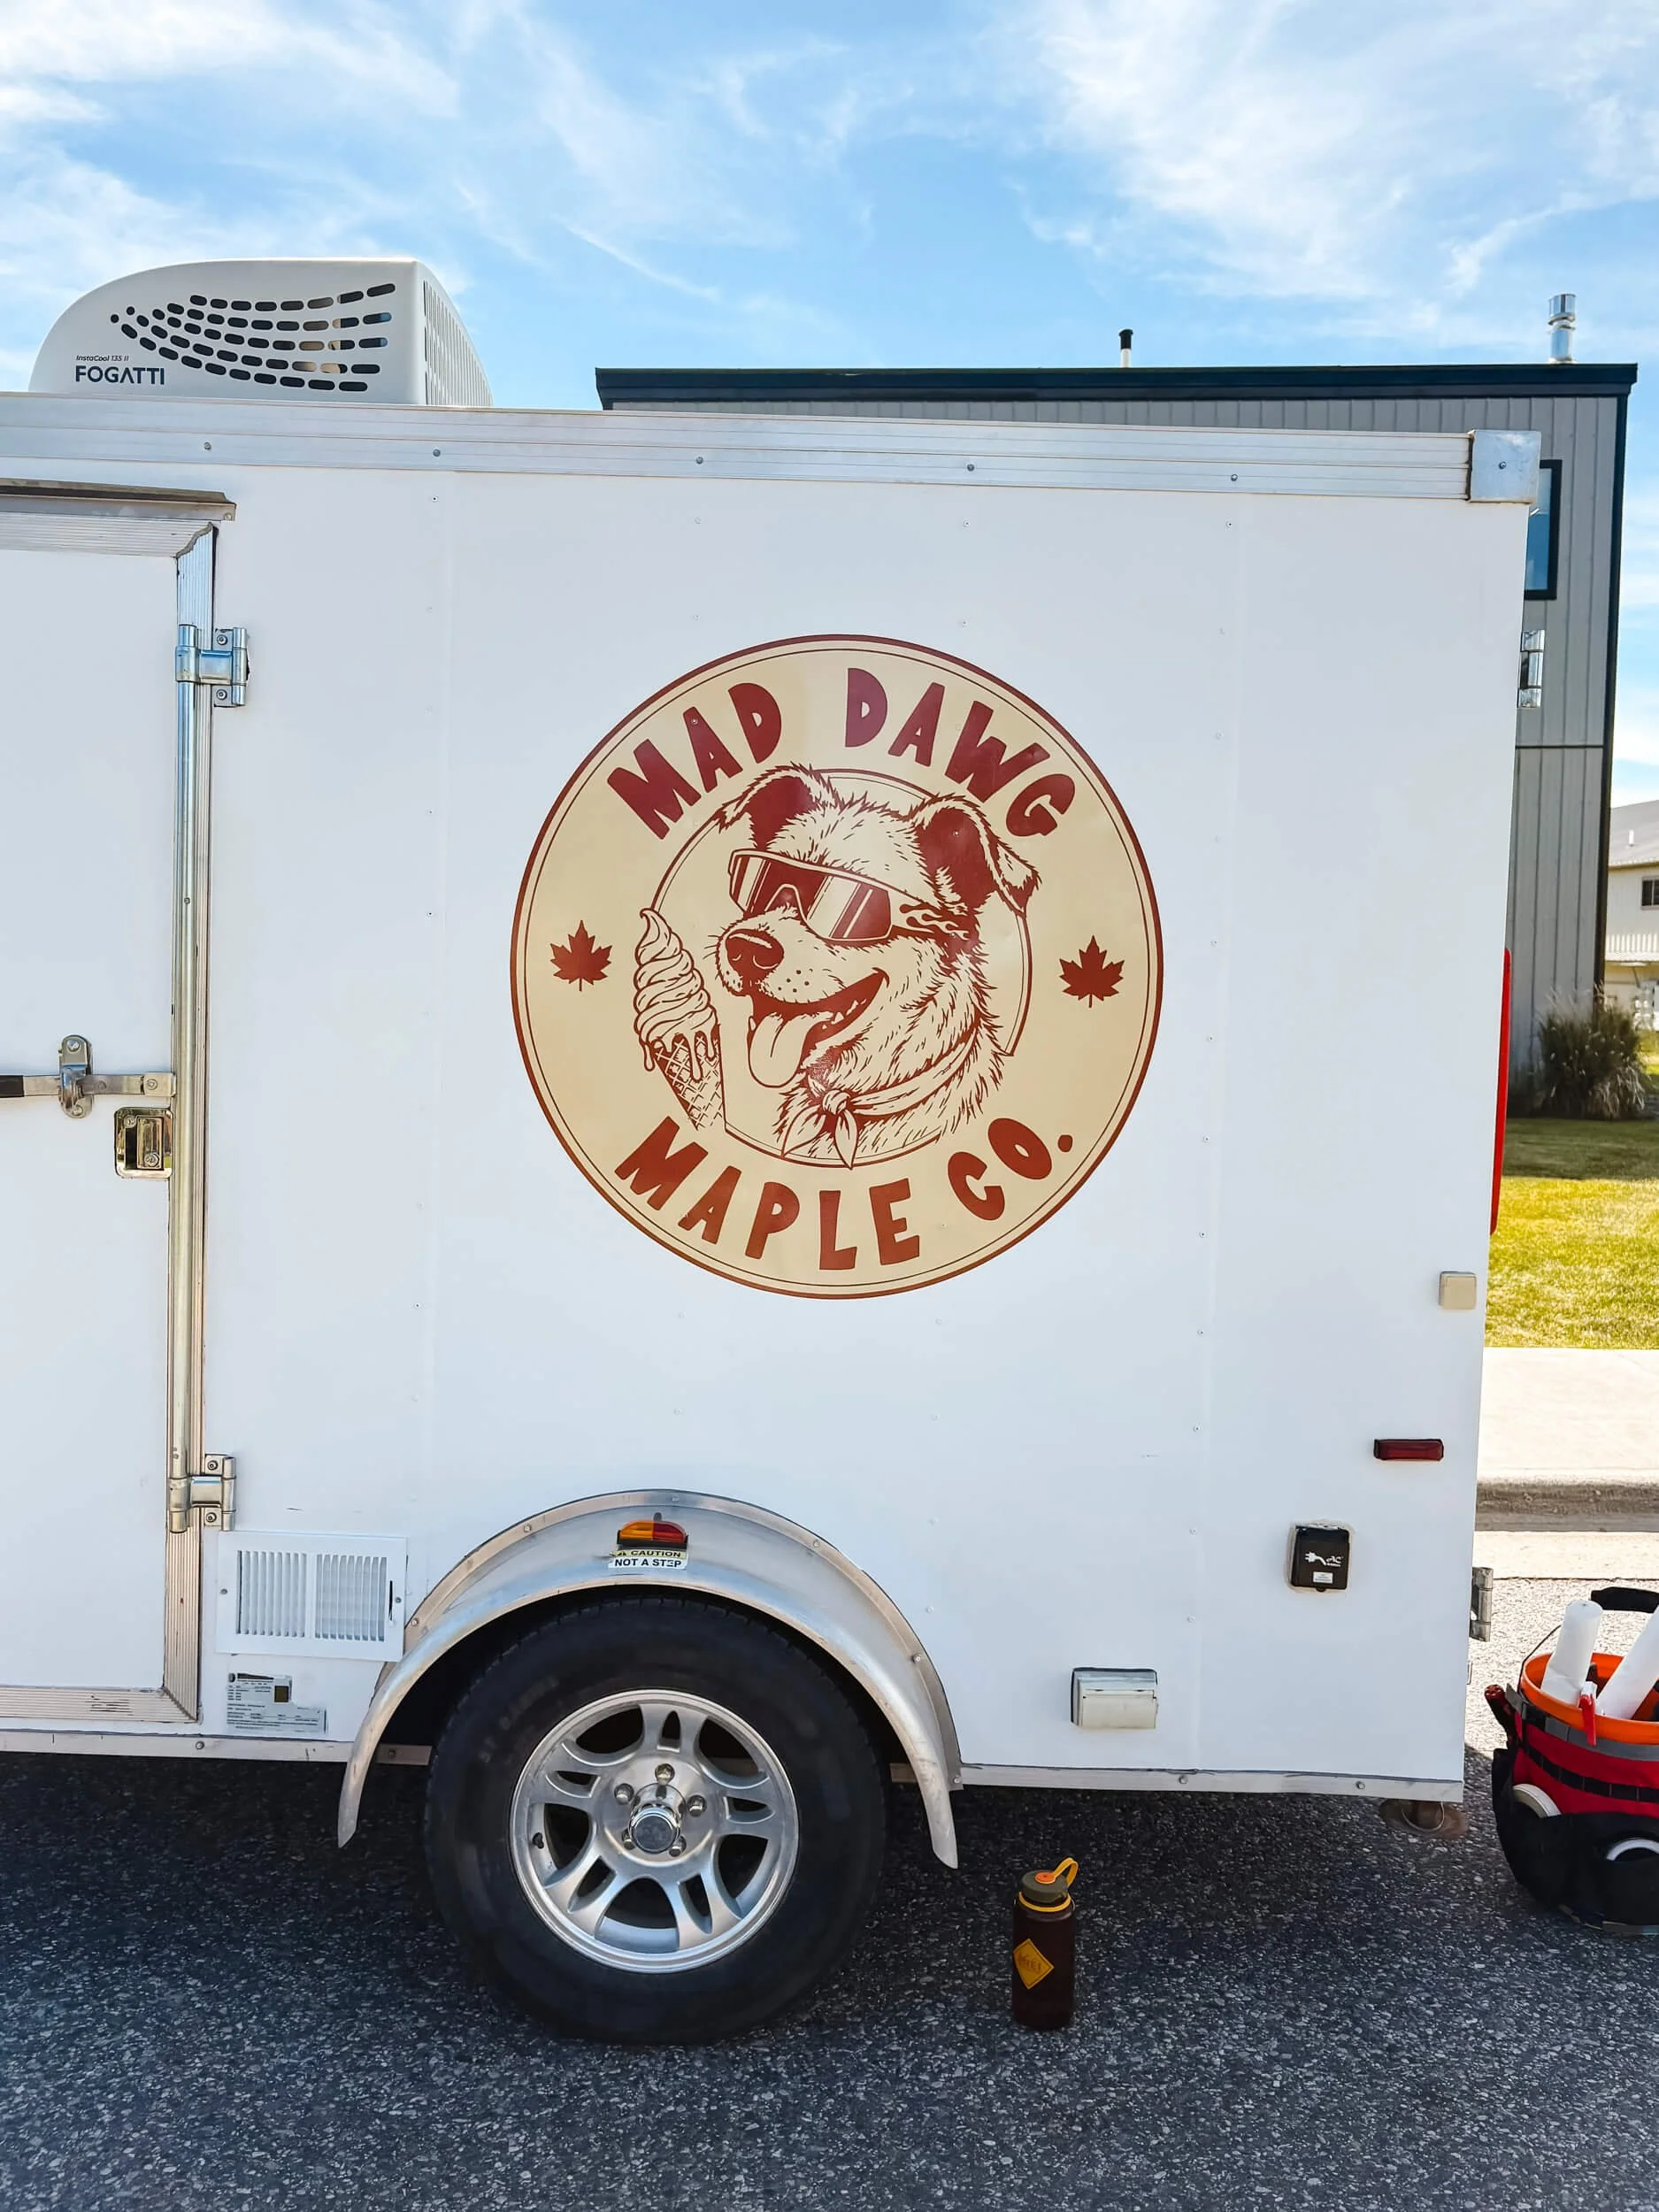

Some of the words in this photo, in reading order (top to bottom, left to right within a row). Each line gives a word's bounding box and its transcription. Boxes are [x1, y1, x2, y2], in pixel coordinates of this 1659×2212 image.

[75, 365, 165, 385] FOGATTI
[607, 682, 782, 840] MAD
[845, 667, 1076, 838] DAWG
[614, 1116, 921, 1271] MAPLE
[947, 1118, 1073, 1222] CO.
[615, 1558, 638, 1567] NOT
[652, 1558, 681, 1568] STEP
